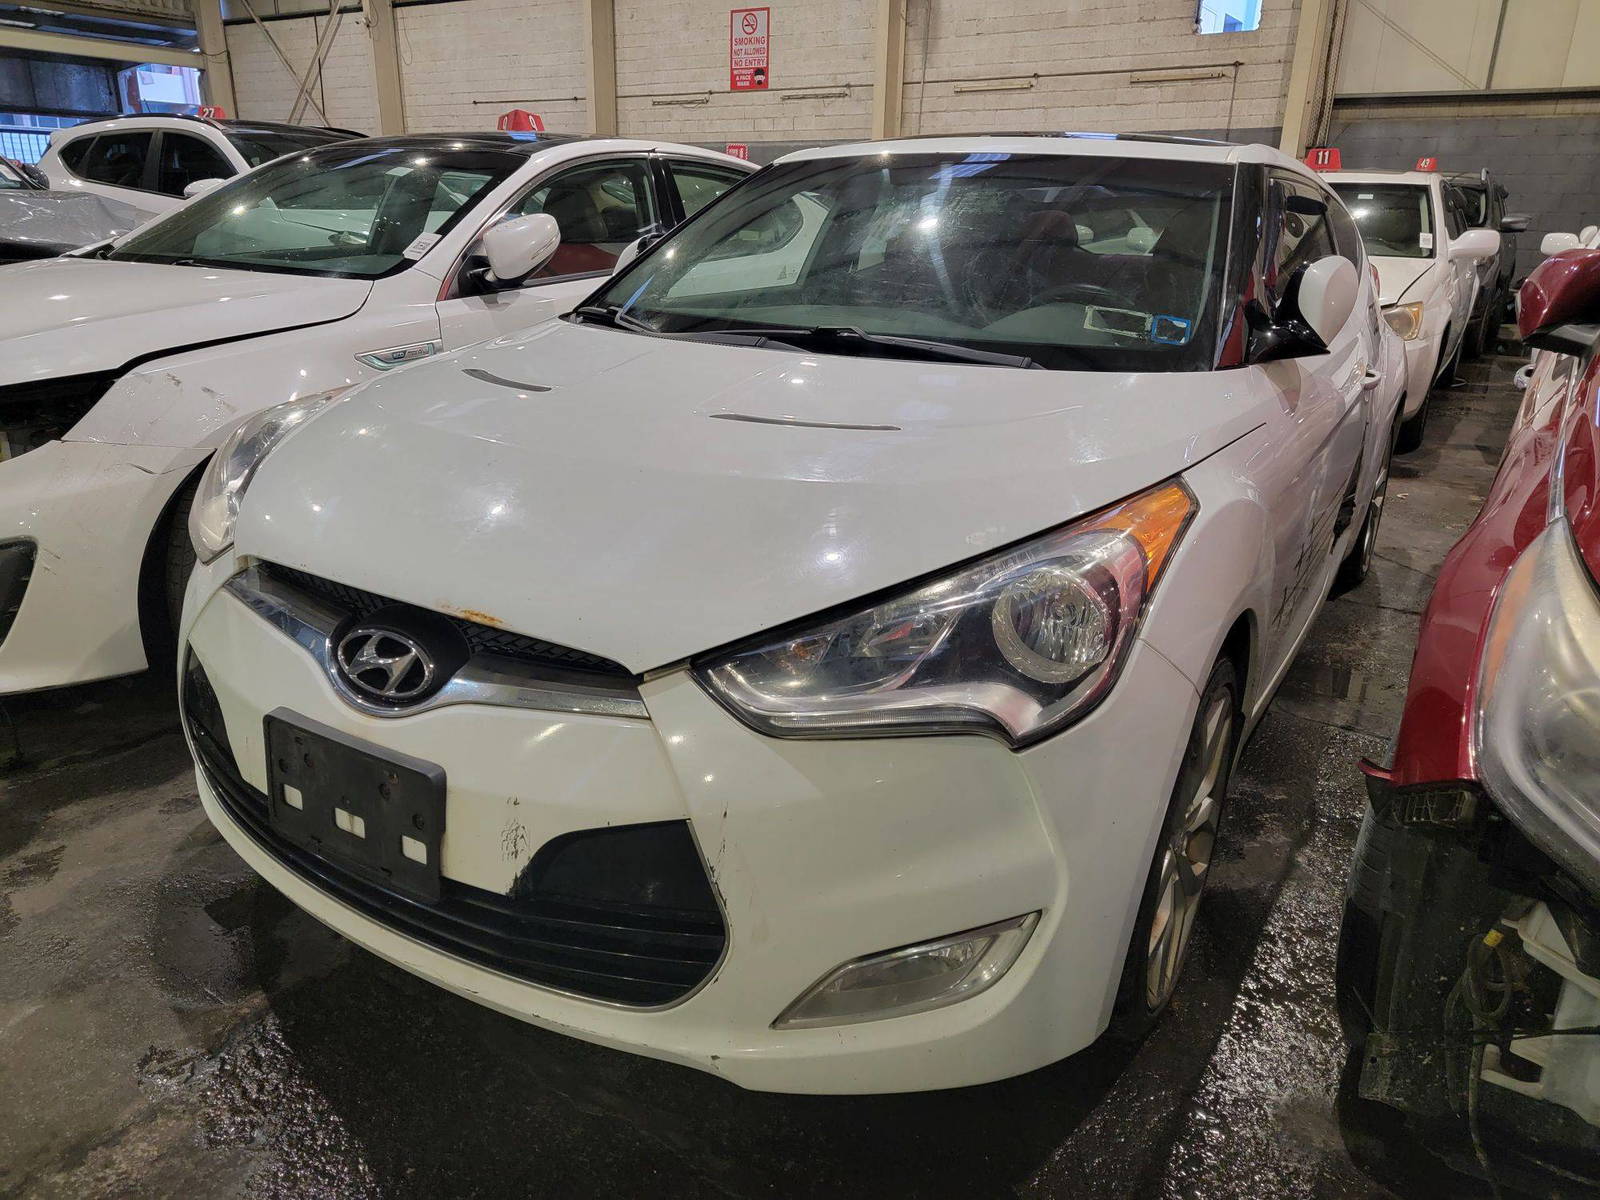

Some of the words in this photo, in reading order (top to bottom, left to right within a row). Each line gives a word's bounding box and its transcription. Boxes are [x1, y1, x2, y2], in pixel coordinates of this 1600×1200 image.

[734, 36, 766, 46] SMOKING
[734, 48, 743, 56] NOT
[744, 47, 766, 55] ALLOWED
[744, 58, 766, 67] ENTRY
[203, 107, 215, 118] 27
[1318, 150, 1330, 164] 11
